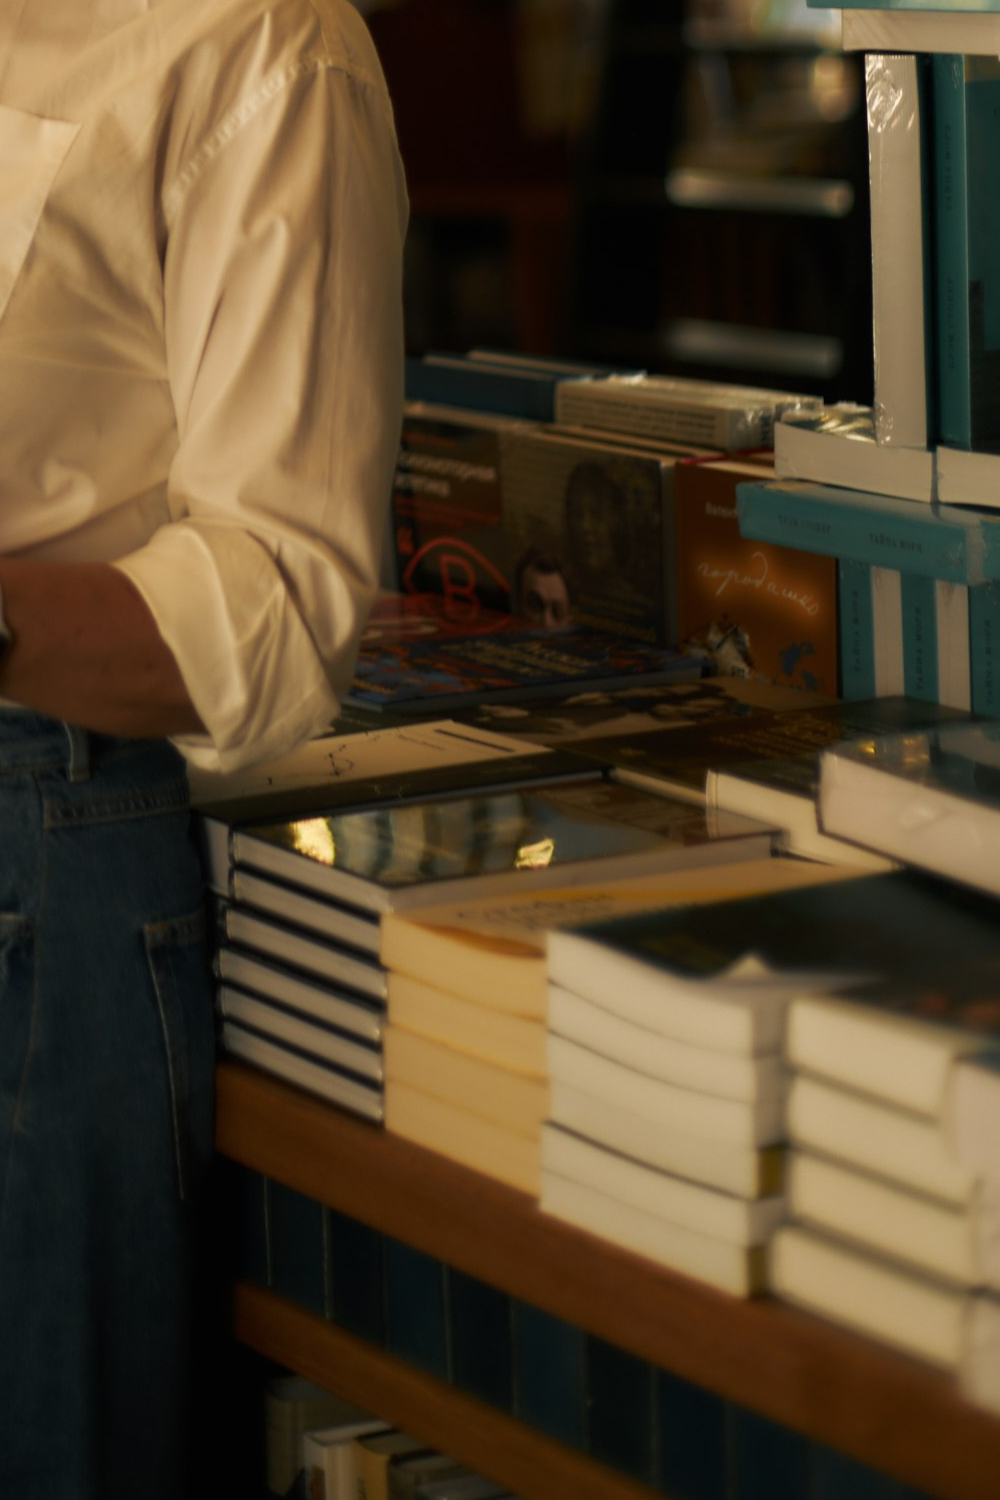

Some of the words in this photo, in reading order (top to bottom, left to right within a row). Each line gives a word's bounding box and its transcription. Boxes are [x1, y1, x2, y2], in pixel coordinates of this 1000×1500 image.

[868, 533, 897, 549] ТАЙНА
[899, 538, 923, 553] МОРЯ
[914, 606, 922, 642] МОРЯ
[915, 647, 923, 691] ТАЙНА
